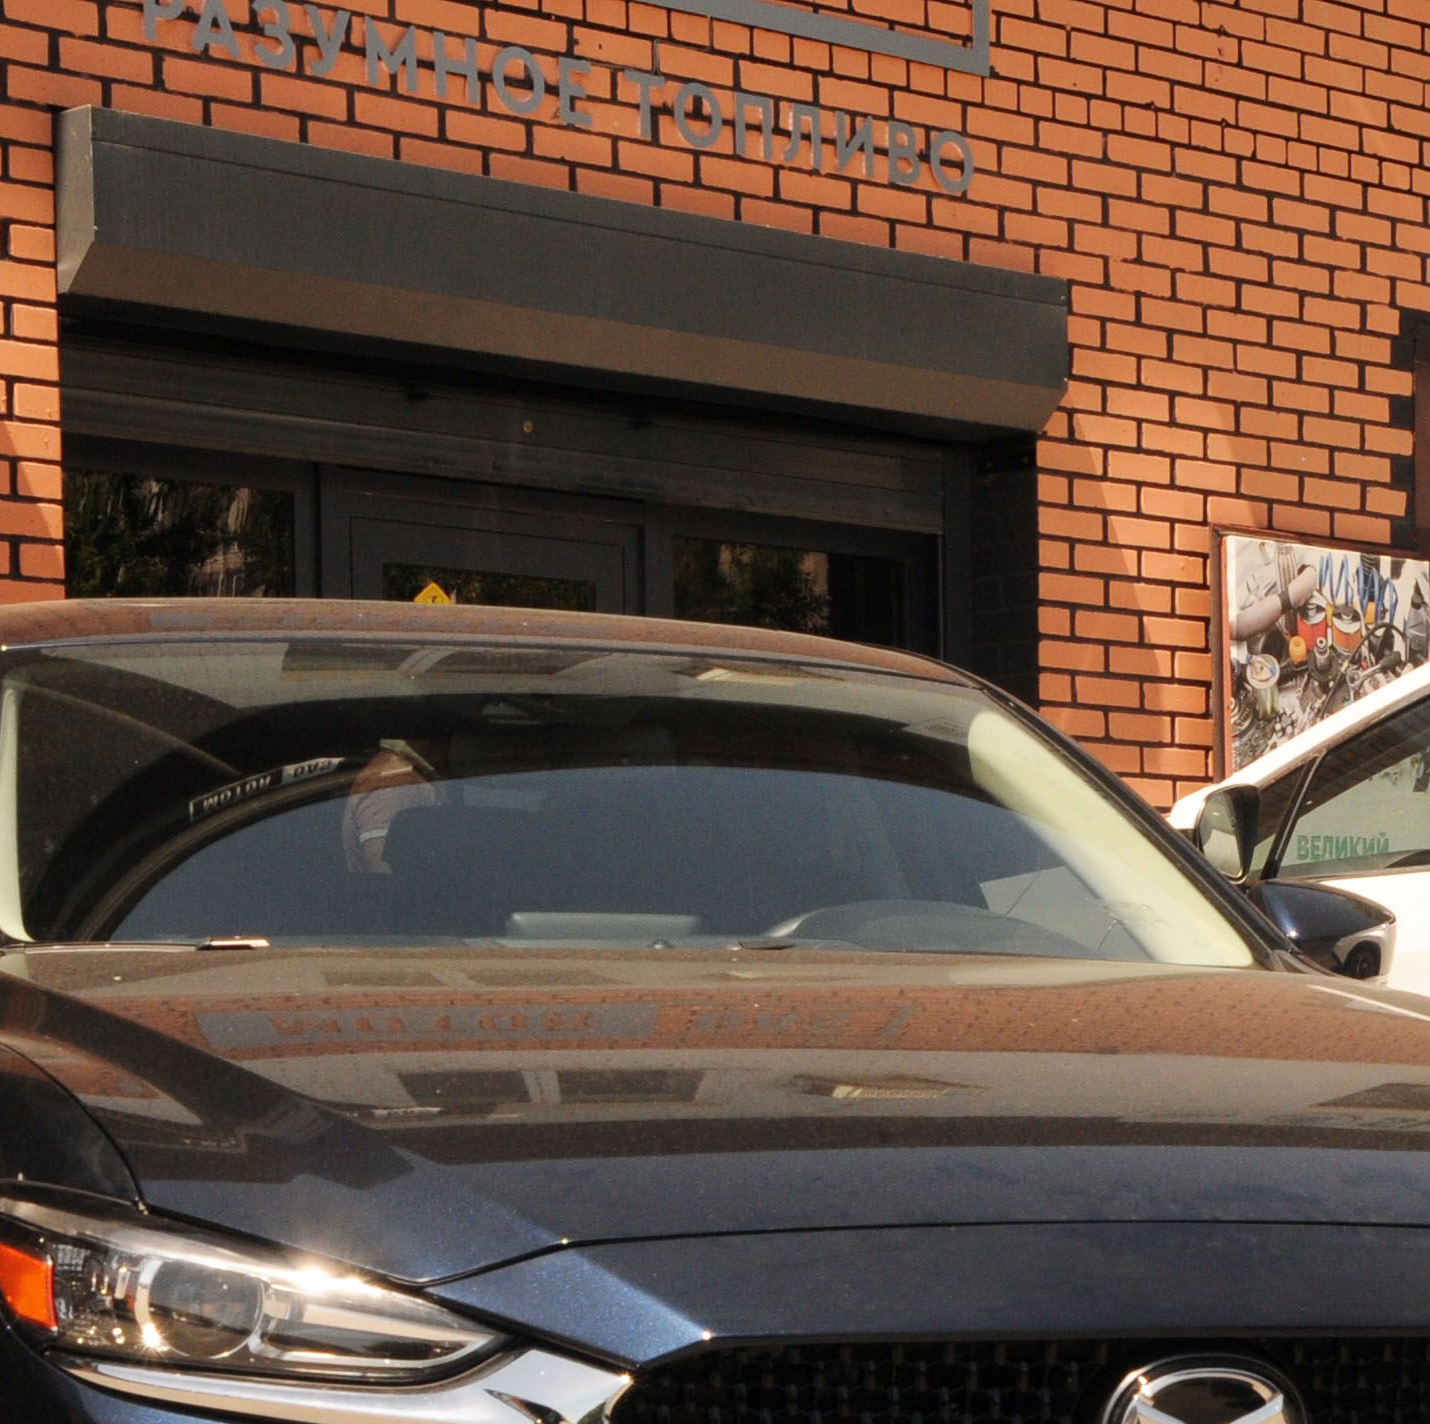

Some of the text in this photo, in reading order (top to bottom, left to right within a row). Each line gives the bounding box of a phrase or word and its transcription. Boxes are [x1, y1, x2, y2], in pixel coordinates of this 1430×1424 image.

[140, 0, 974, 194] РАЗУМНОЕ ТОПЛИВО
[1296, 831, 1390, 862] ВЕЛИКИЙ
